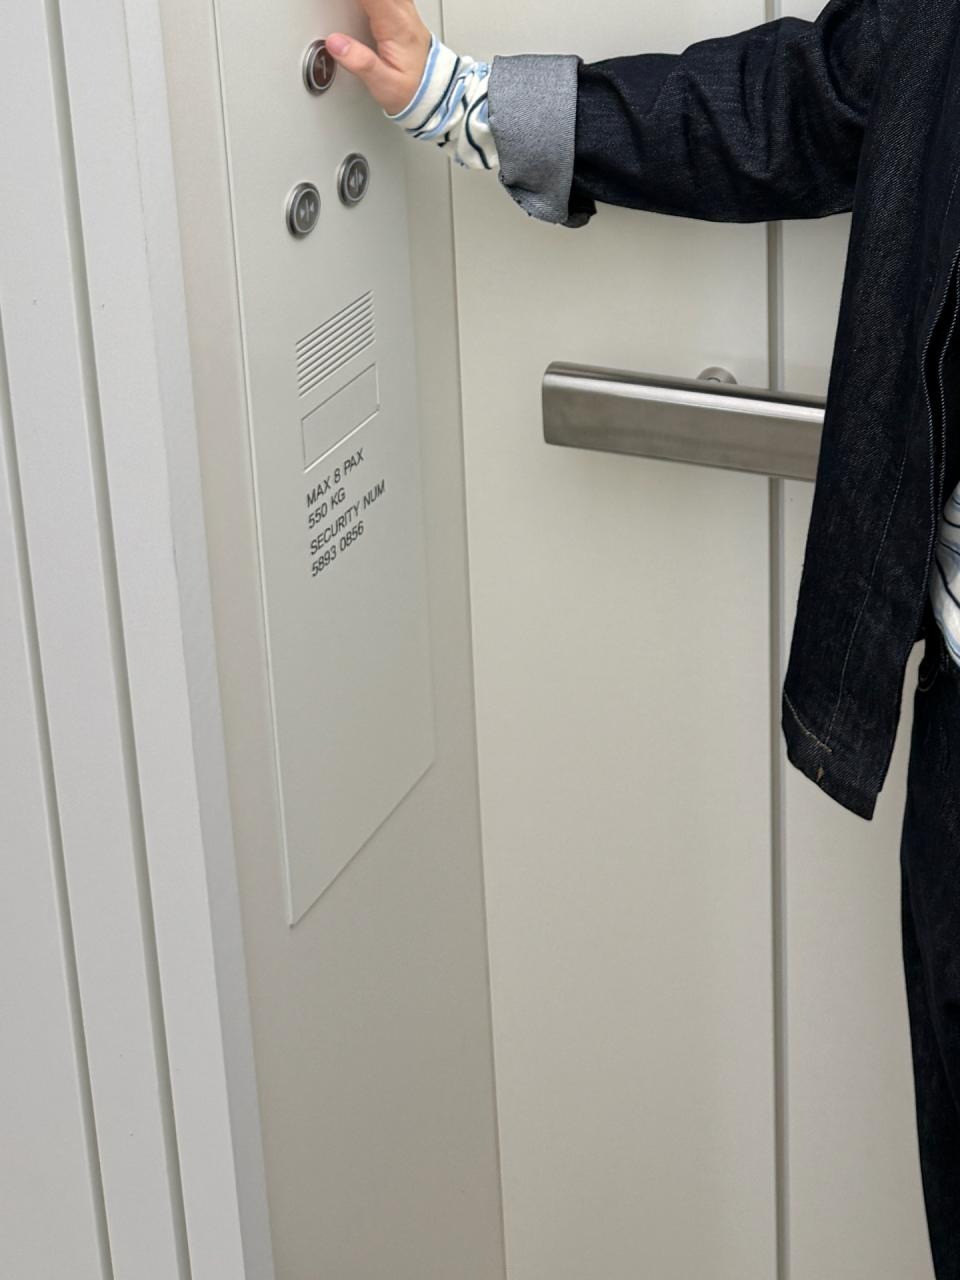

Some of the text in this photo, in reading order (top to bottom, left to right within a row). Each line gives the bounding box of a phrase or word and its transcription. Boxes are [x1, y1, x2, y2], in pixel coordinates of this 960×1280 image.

[306, 447, 364, 508] MAX 8 PAX
[308, 487, 346, 529] 550 KG
[310, 478, 385, 555] SECURITY NUM
[312, 520, 364, 577] 5893 0856
